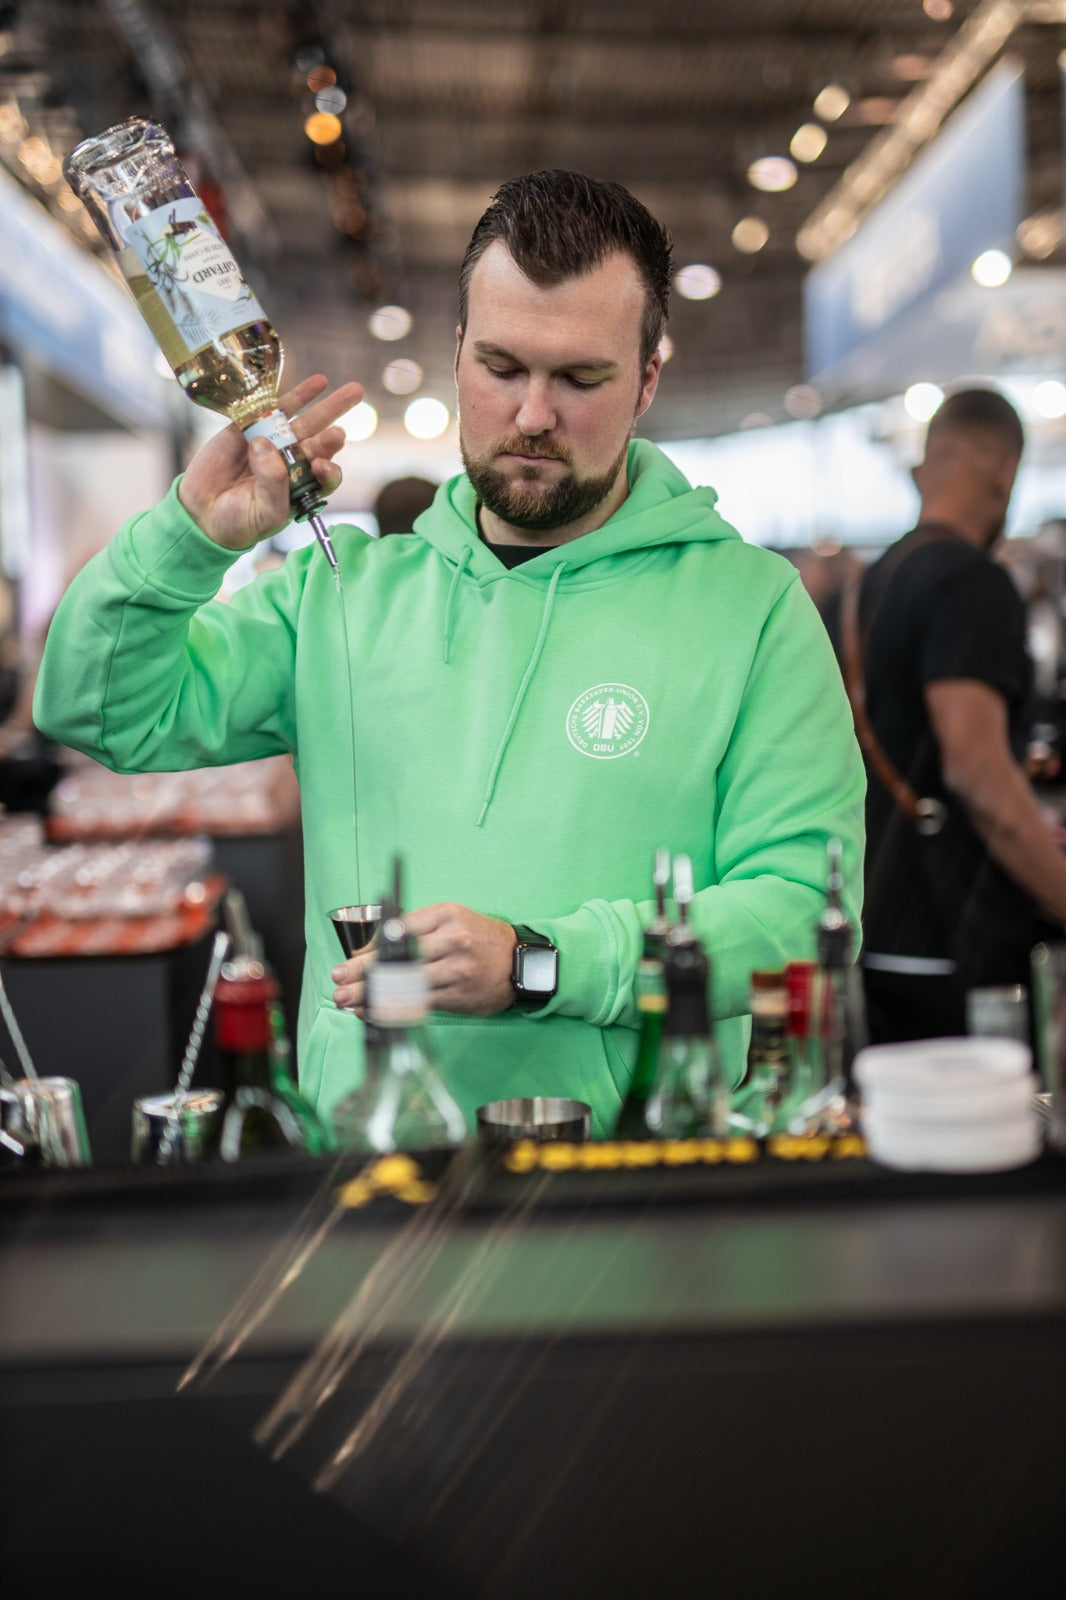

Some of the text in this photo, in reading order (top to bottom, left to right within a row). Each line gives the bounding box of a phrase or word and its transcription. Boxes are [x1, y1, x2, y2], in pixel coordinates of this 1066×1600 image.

[192, 261, 237, 283] GIFFARD
[570, 715, 589, 749] DEUTSCHE
[634, 720, 645, 736] VON
[592, 743, 615, 752] DBU
